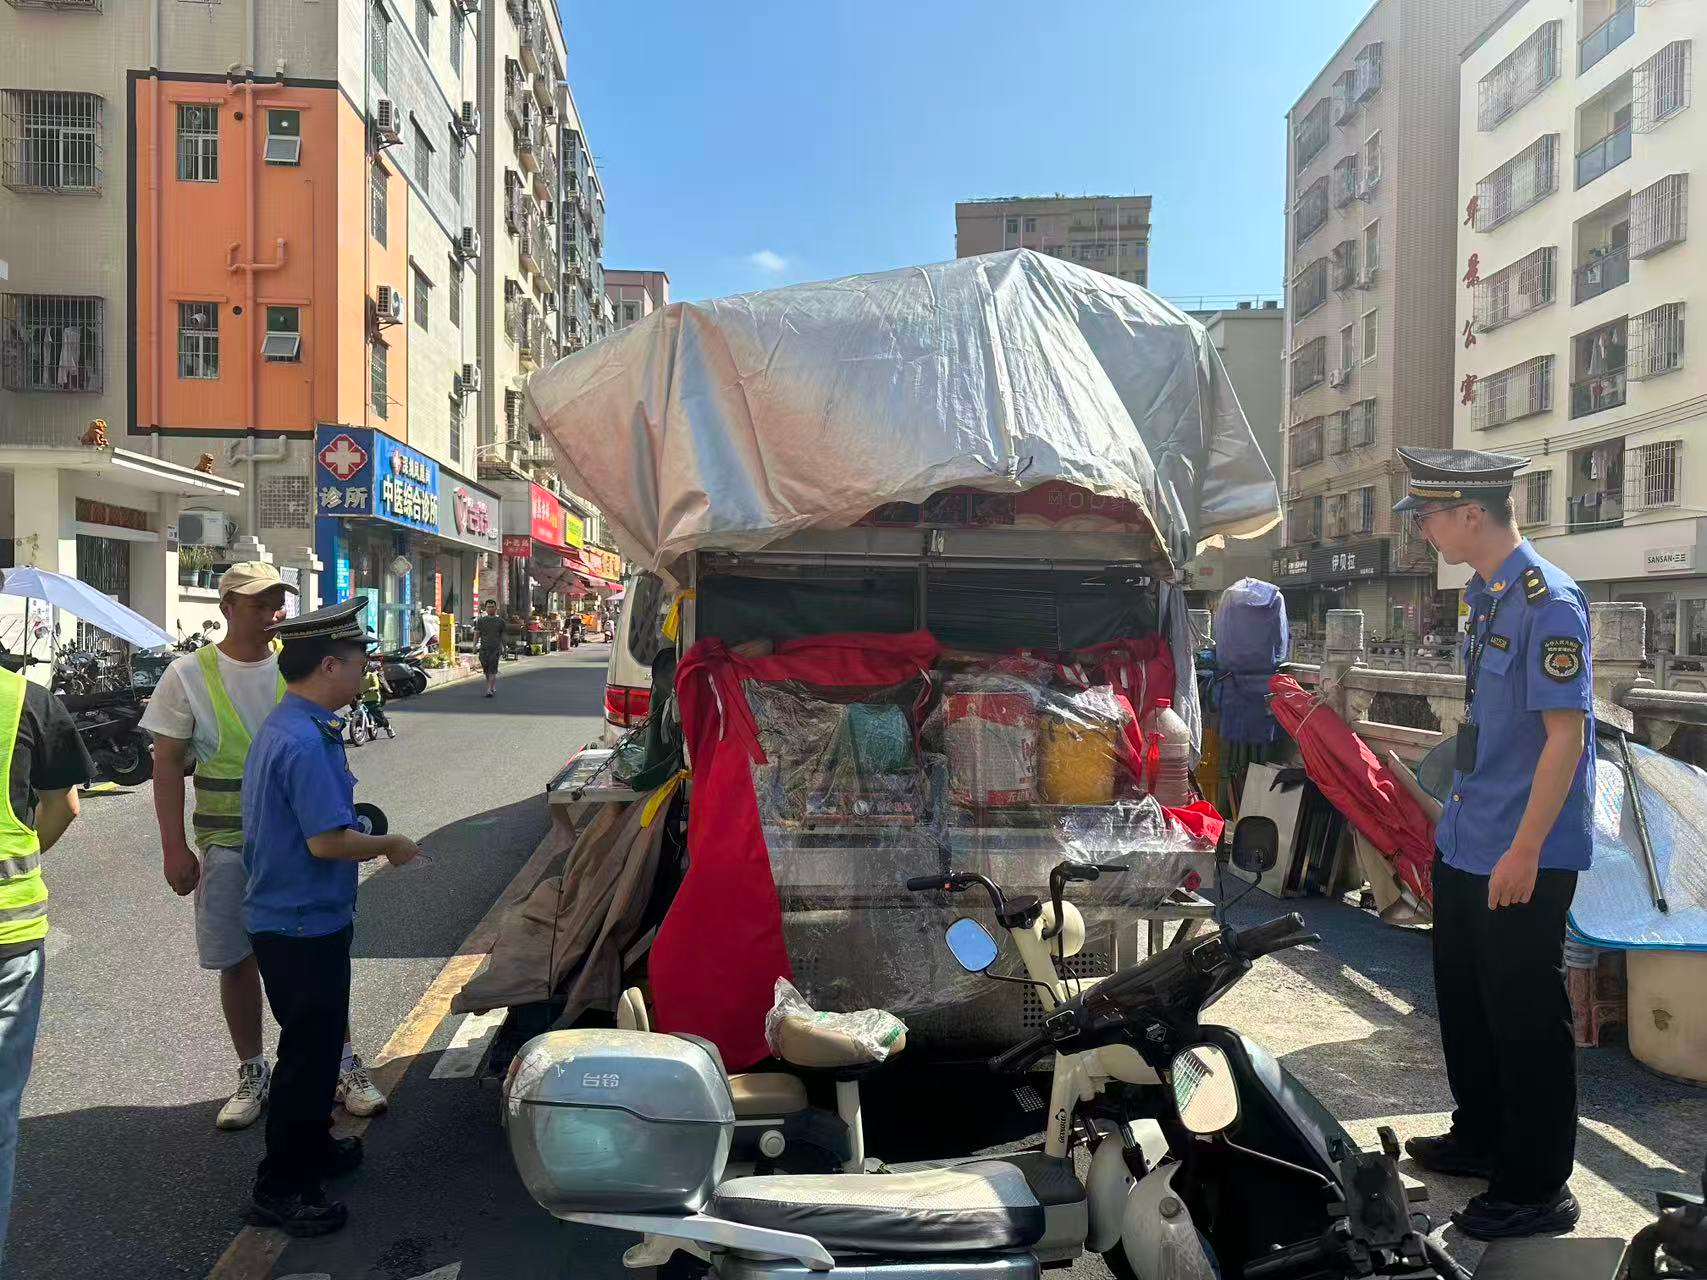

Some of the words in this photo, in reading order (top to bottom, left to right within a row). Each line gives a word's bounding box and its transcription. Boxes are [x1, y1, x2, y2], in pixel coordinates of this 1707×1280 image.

[319, 486, 368, 509] 诊所
[383, 474, 438, 525] 中医综合诊所
[1332, 552, 1356, 572] 伊贝拉
[582, 1072, 620, 1087] 台铃
